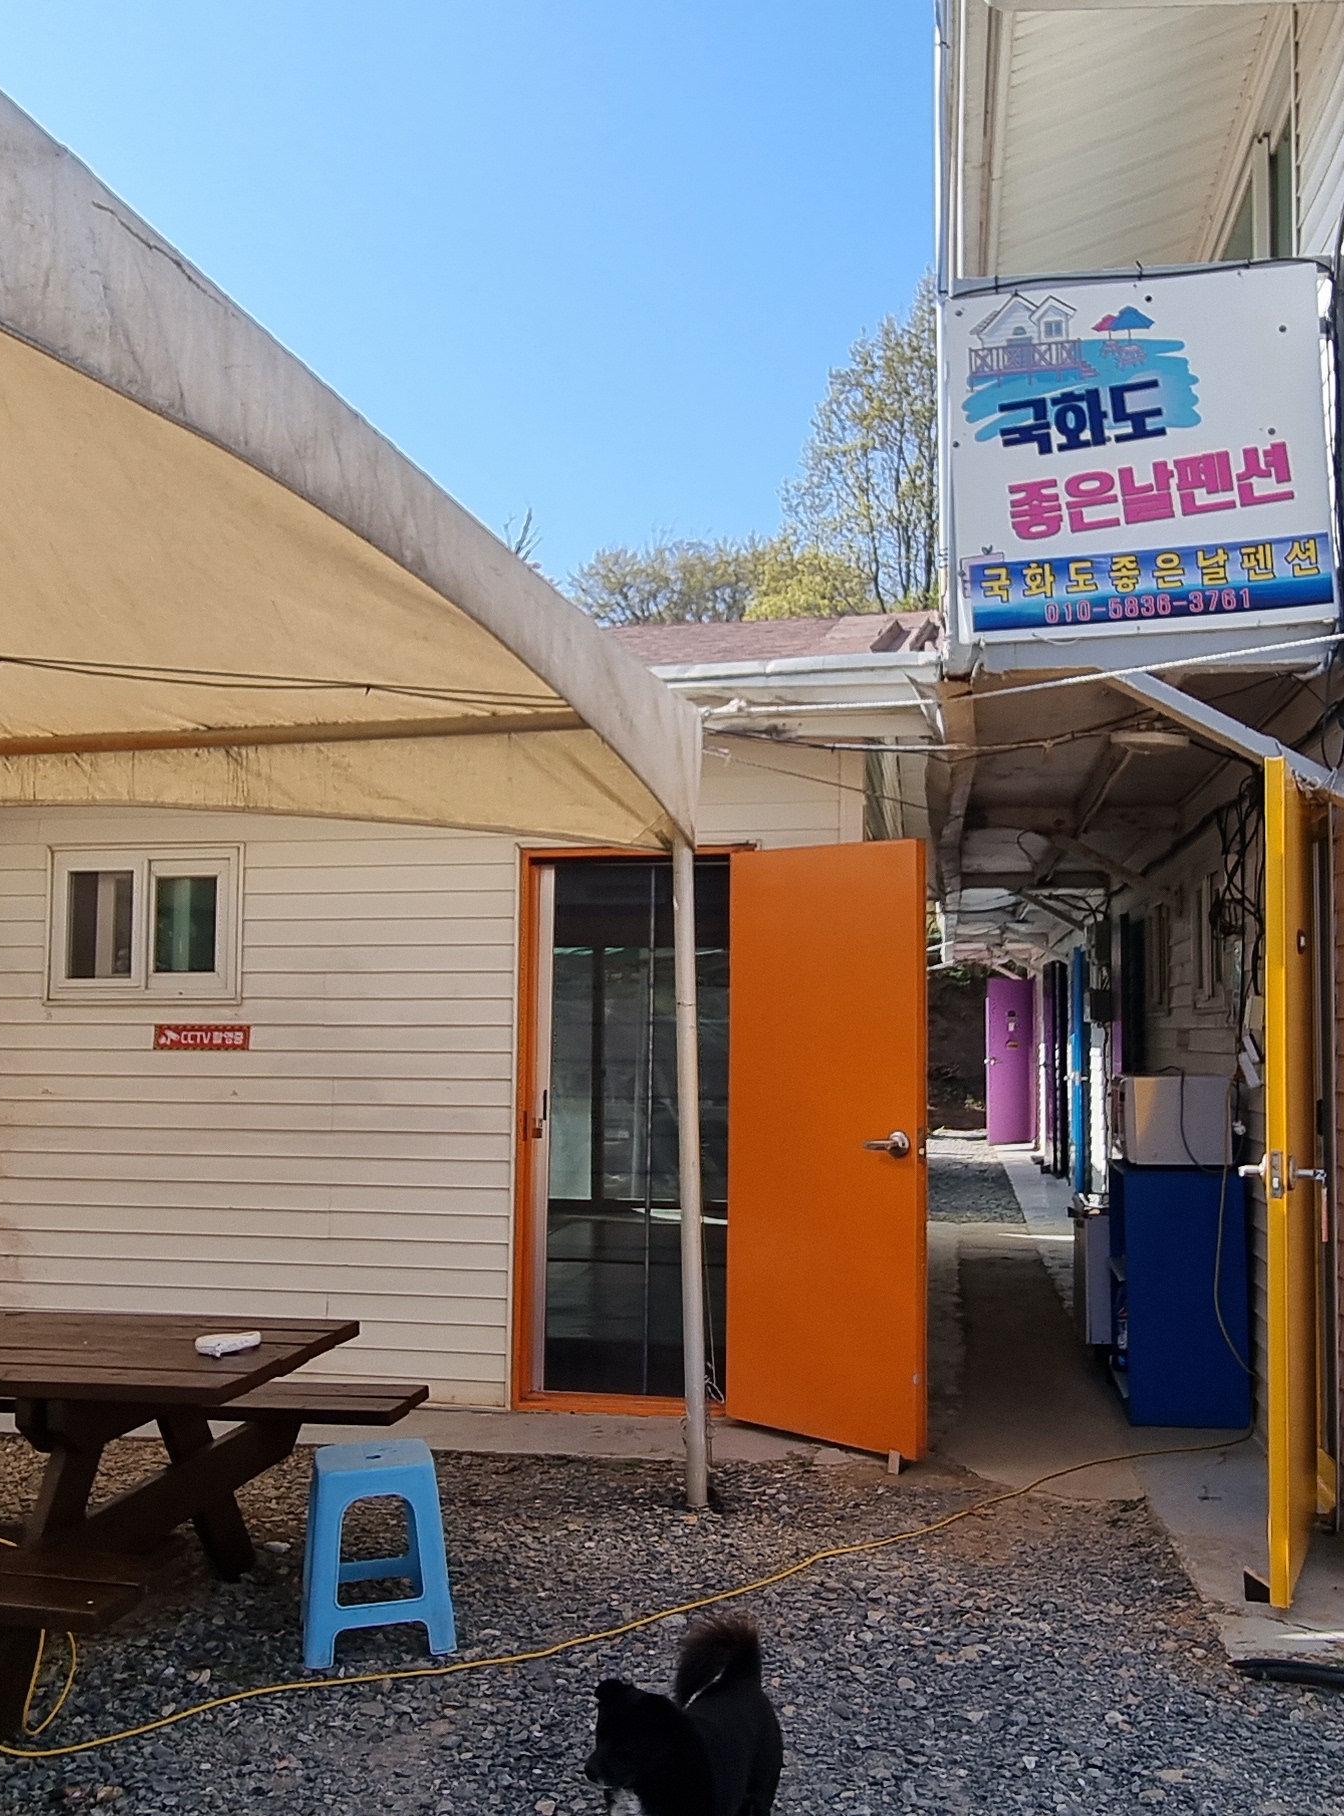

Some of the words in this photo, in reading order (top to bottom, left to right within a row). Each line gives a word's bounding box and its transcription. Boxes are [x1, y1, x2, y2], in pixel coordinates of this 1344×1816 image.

[998, 379, 1167, 455] 국화도
[1008, 441, 1295, 540] 좋은날펜션
[1045, 587, 1251, 625] 010-5836-3761
[181, 1031, 211, 1044] CCTV
